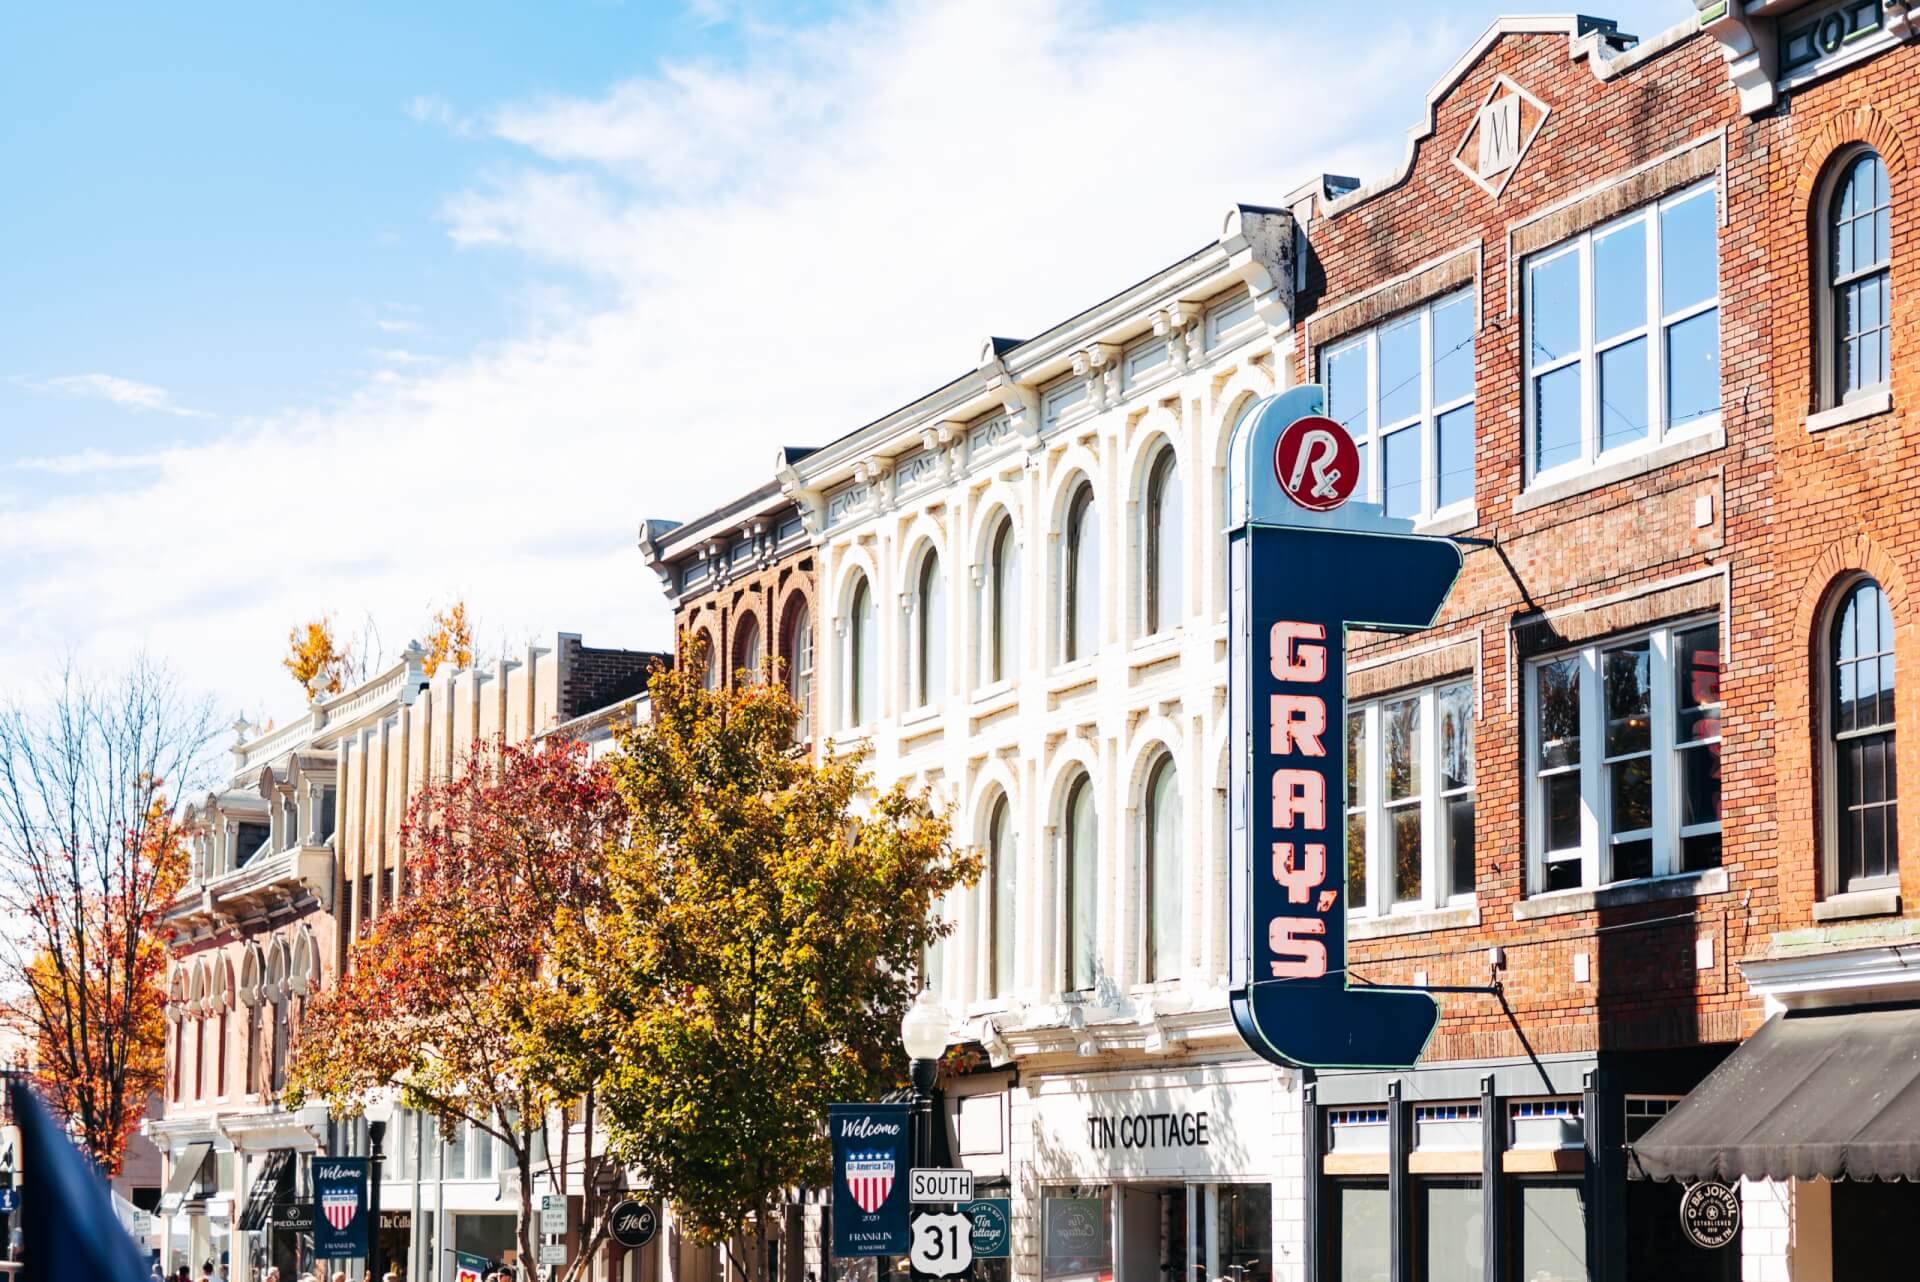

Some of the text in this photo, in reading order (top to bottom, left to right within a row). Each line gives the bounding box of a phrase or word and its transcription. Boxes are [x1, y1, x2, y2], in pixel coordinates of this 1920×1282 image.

[1483, 105, 1513, 169] M
[1269, 621, 1337, 978] GRAY'S
[841, 1116, 900, 1139] Welcome
[1088, 1112, 1209, 1149] TIN COTTAGE
[319, 1164, 361, 1180] Welcome
[915, 1175, 969, 1195] SOUTH
[1703, 1186, 1736, 1217] JOYFUL
[380, 1215, 392, 1228] The
[975, 1214, 991, 1227] Tin
[849, 1232, 892, 1241] FRANKLIN
[923, 1225, 957, 1260] 31
